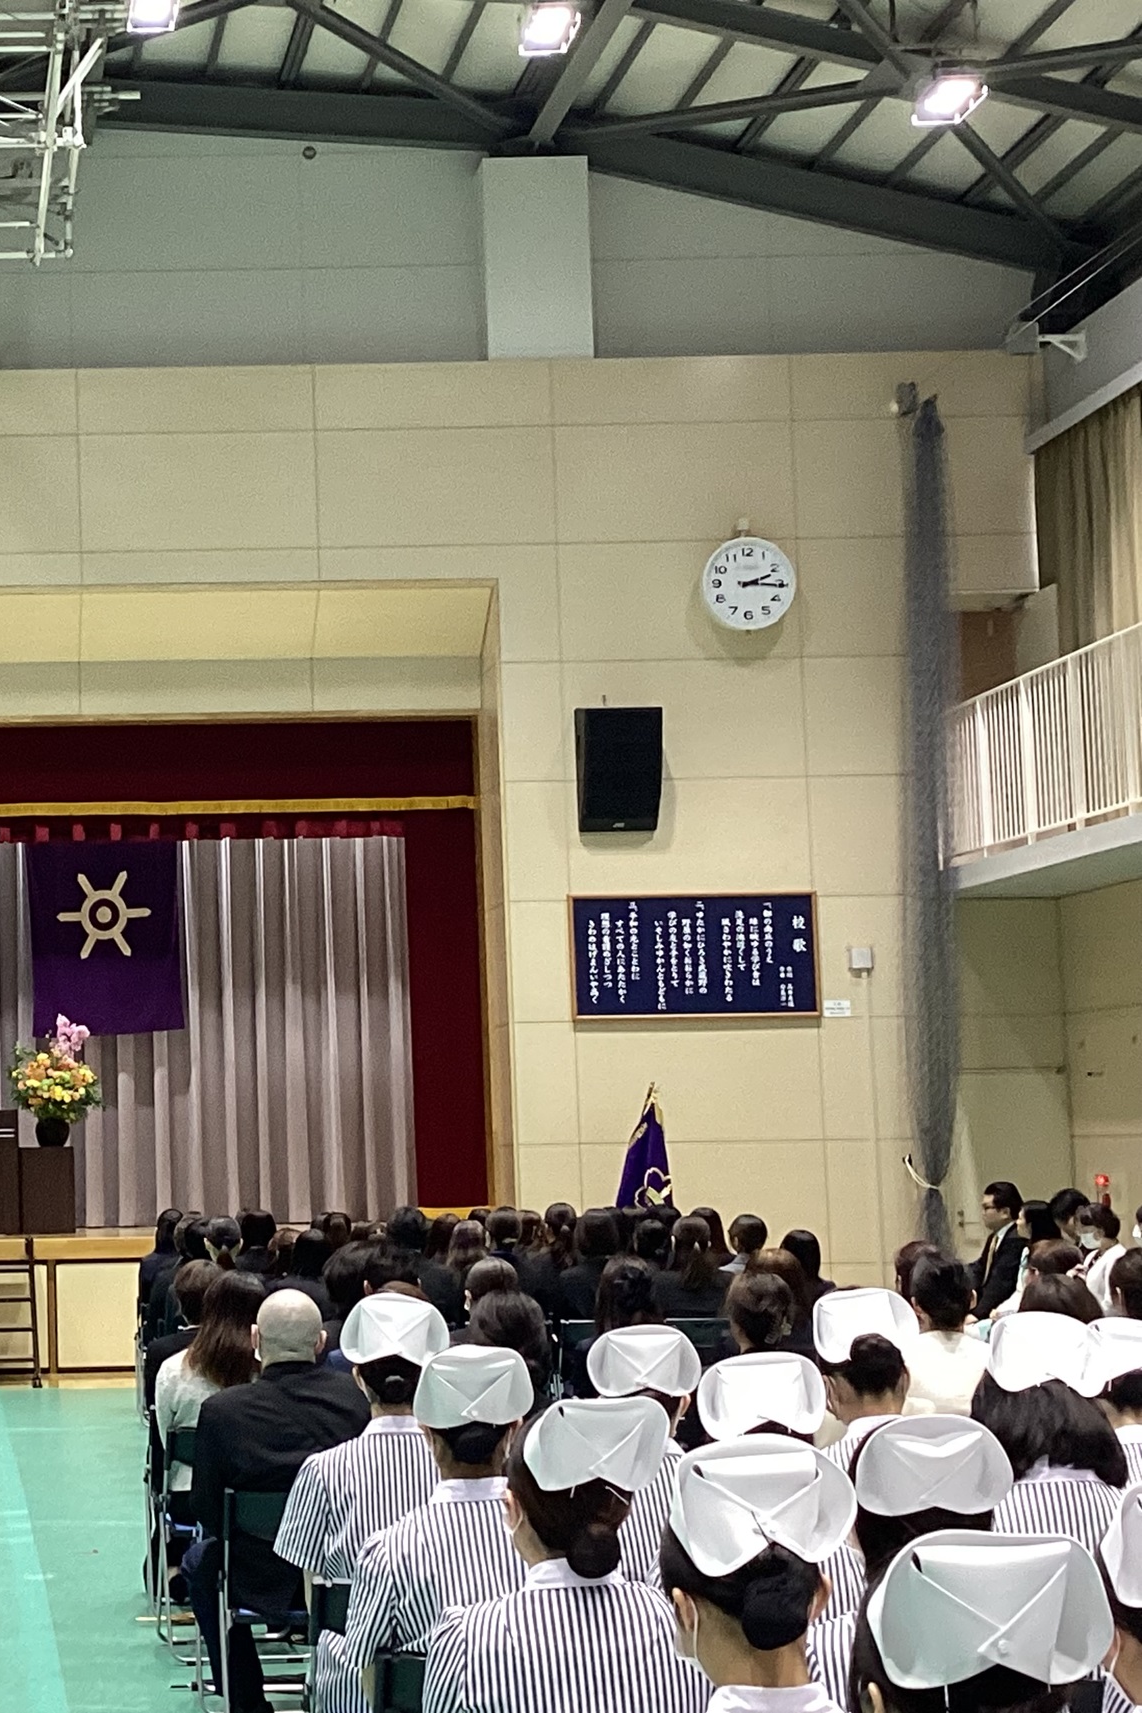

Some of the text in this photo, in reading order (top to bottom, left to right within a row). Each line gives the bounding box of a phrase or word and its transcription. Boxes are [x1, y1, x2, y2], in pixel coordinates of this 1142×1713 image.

[741, 547, 754, 557] 12
[725, 553, 737, 563] 11
[714, 565, 728, 575] 10
[769, 563, 780, 573] 2
[711, 579, 722, 588] 9
[715, 594, 726, 603] 8
[770, 594, 782, 602] 4
[728, 606, 739, 615] 7
[761, 606, 771, 615] 5
[743, 611, 754, 620] 6
[791, 914, 807, 953] 校歌
